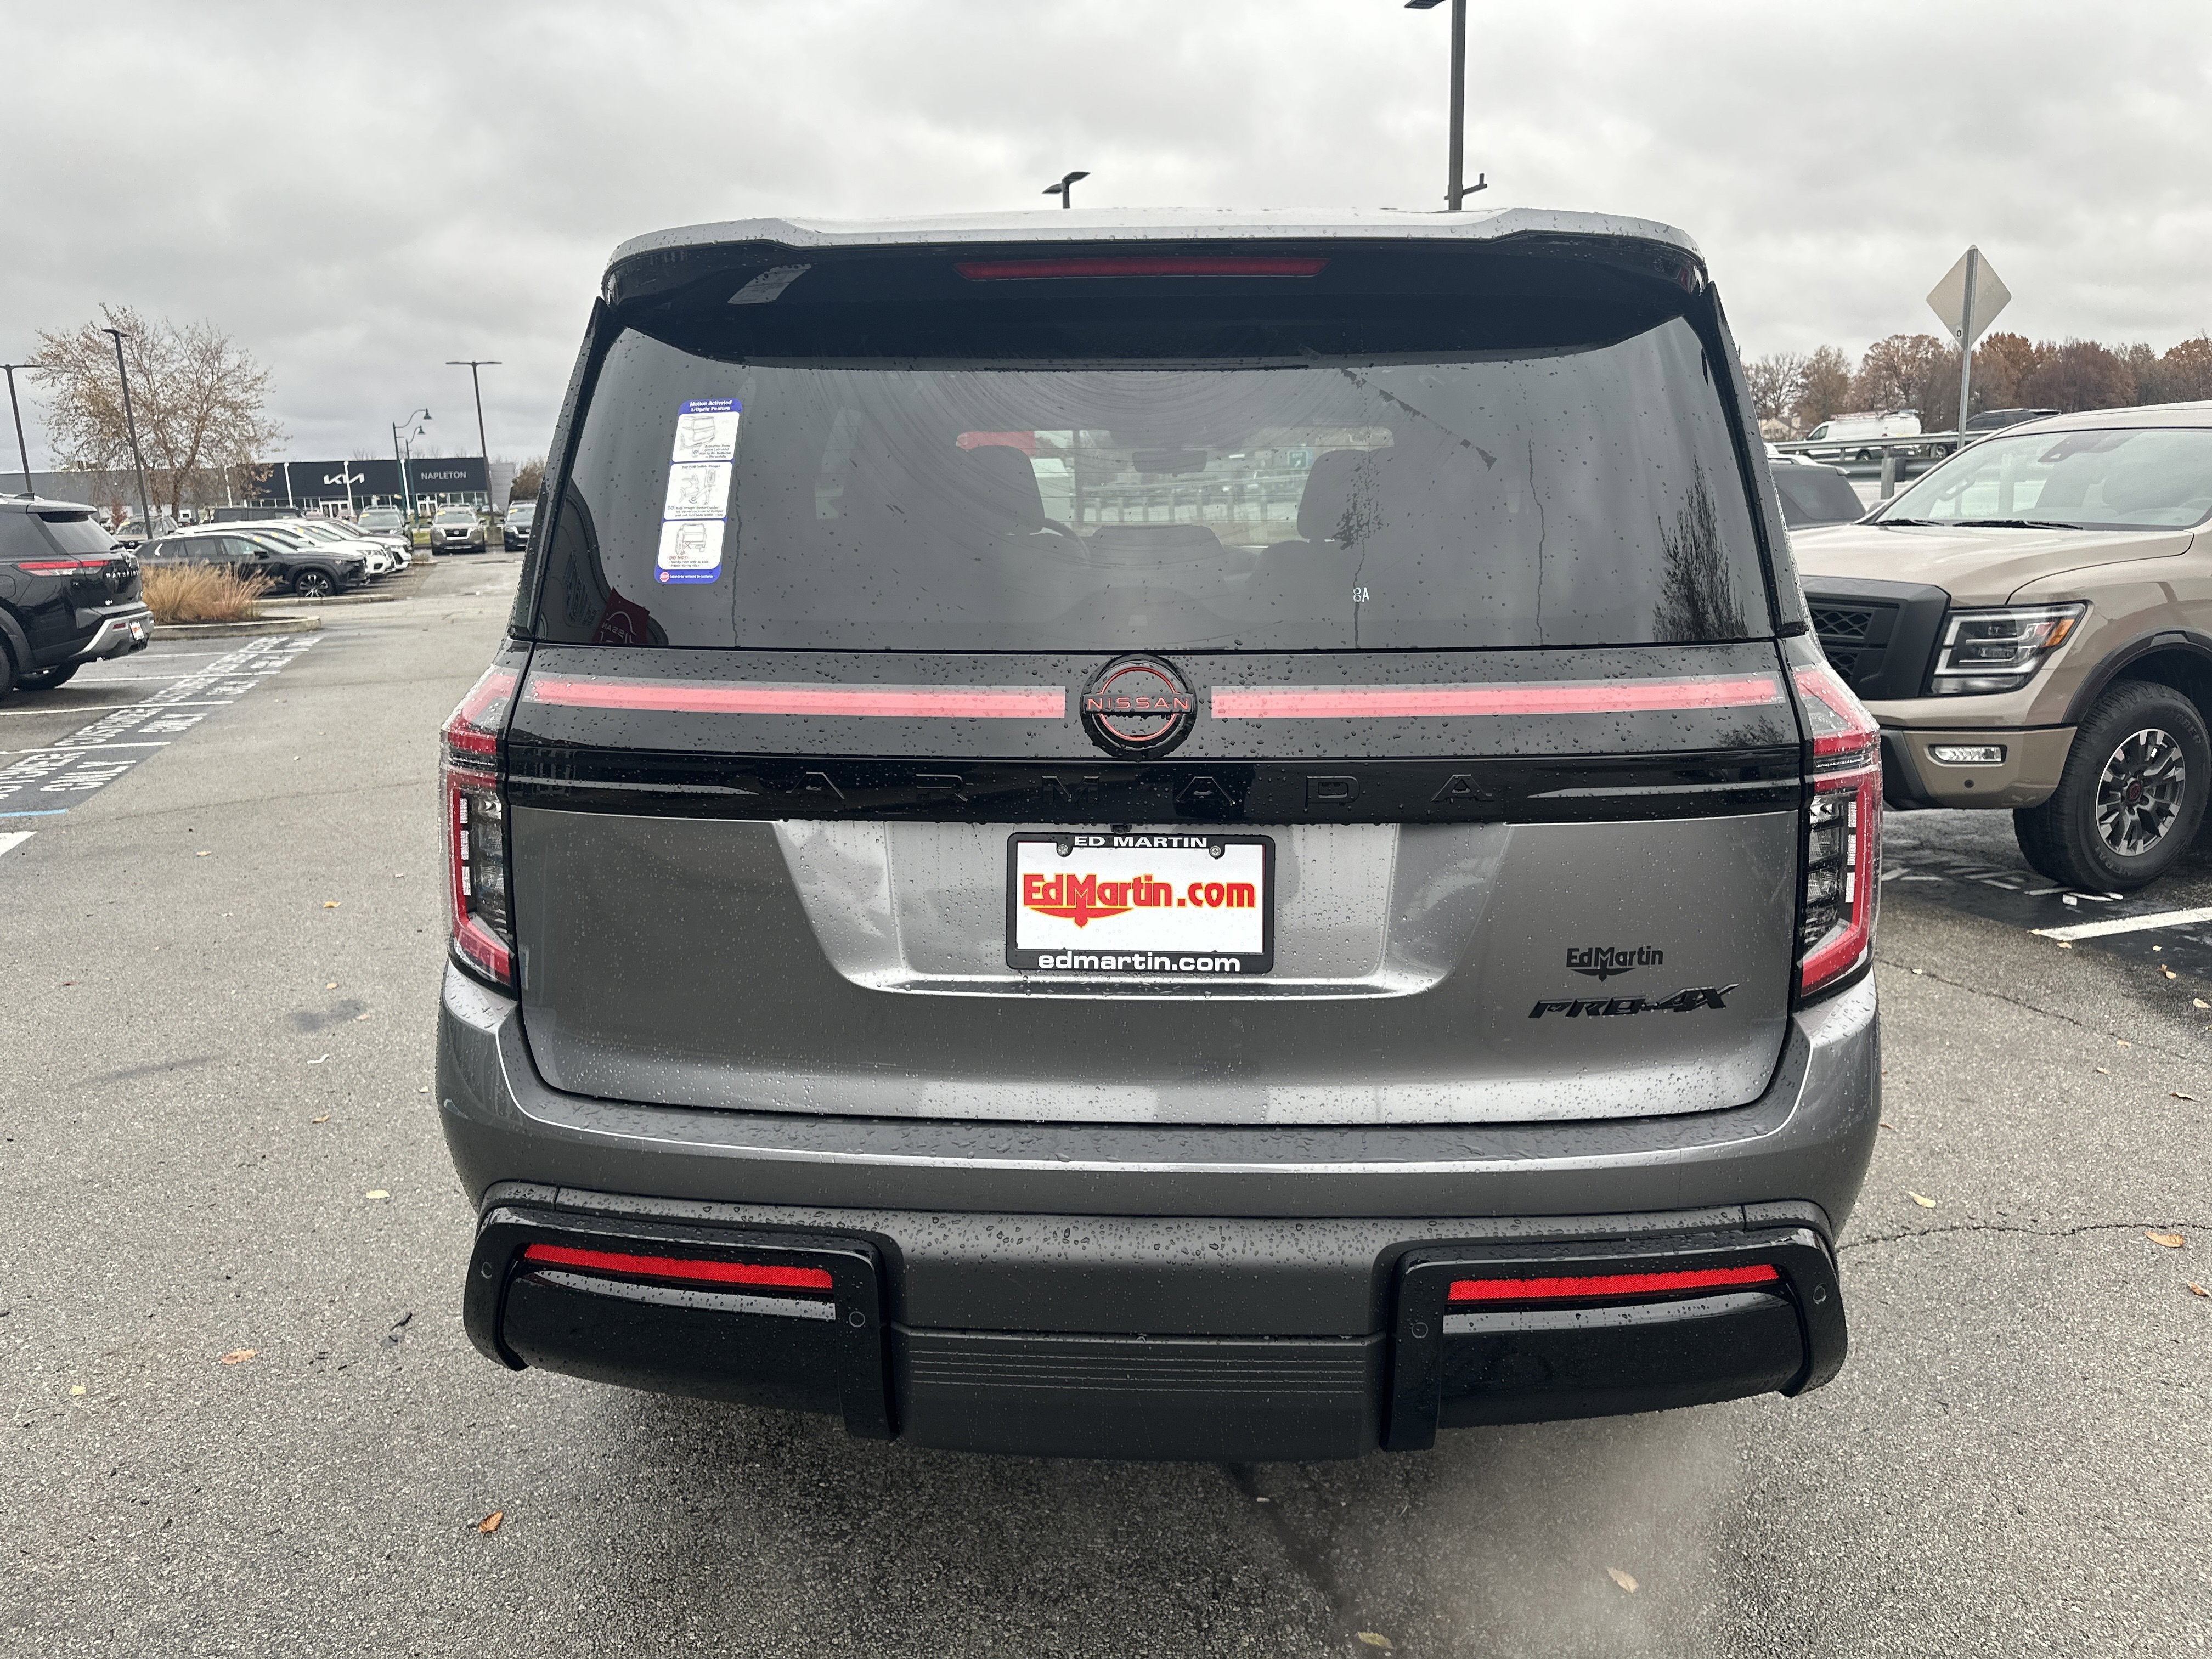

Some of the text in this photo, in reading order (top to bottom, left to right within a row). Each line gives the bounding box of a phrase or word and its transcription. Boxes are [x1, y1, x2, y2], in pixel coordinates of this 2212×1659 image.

[421, 471, 466, 480] NAPLETON
[1087, 696, 1189, 710] NISSAN
[40, 760, 137, 791] ONLY
[785, 772, 1493, 803] ARMADA
[1074, 836, 1208, 849] ED MARTIN
[1038, 950, 1241, 972] edmartin.com
[1528, 983, 1740, 1019] PRO-4X
